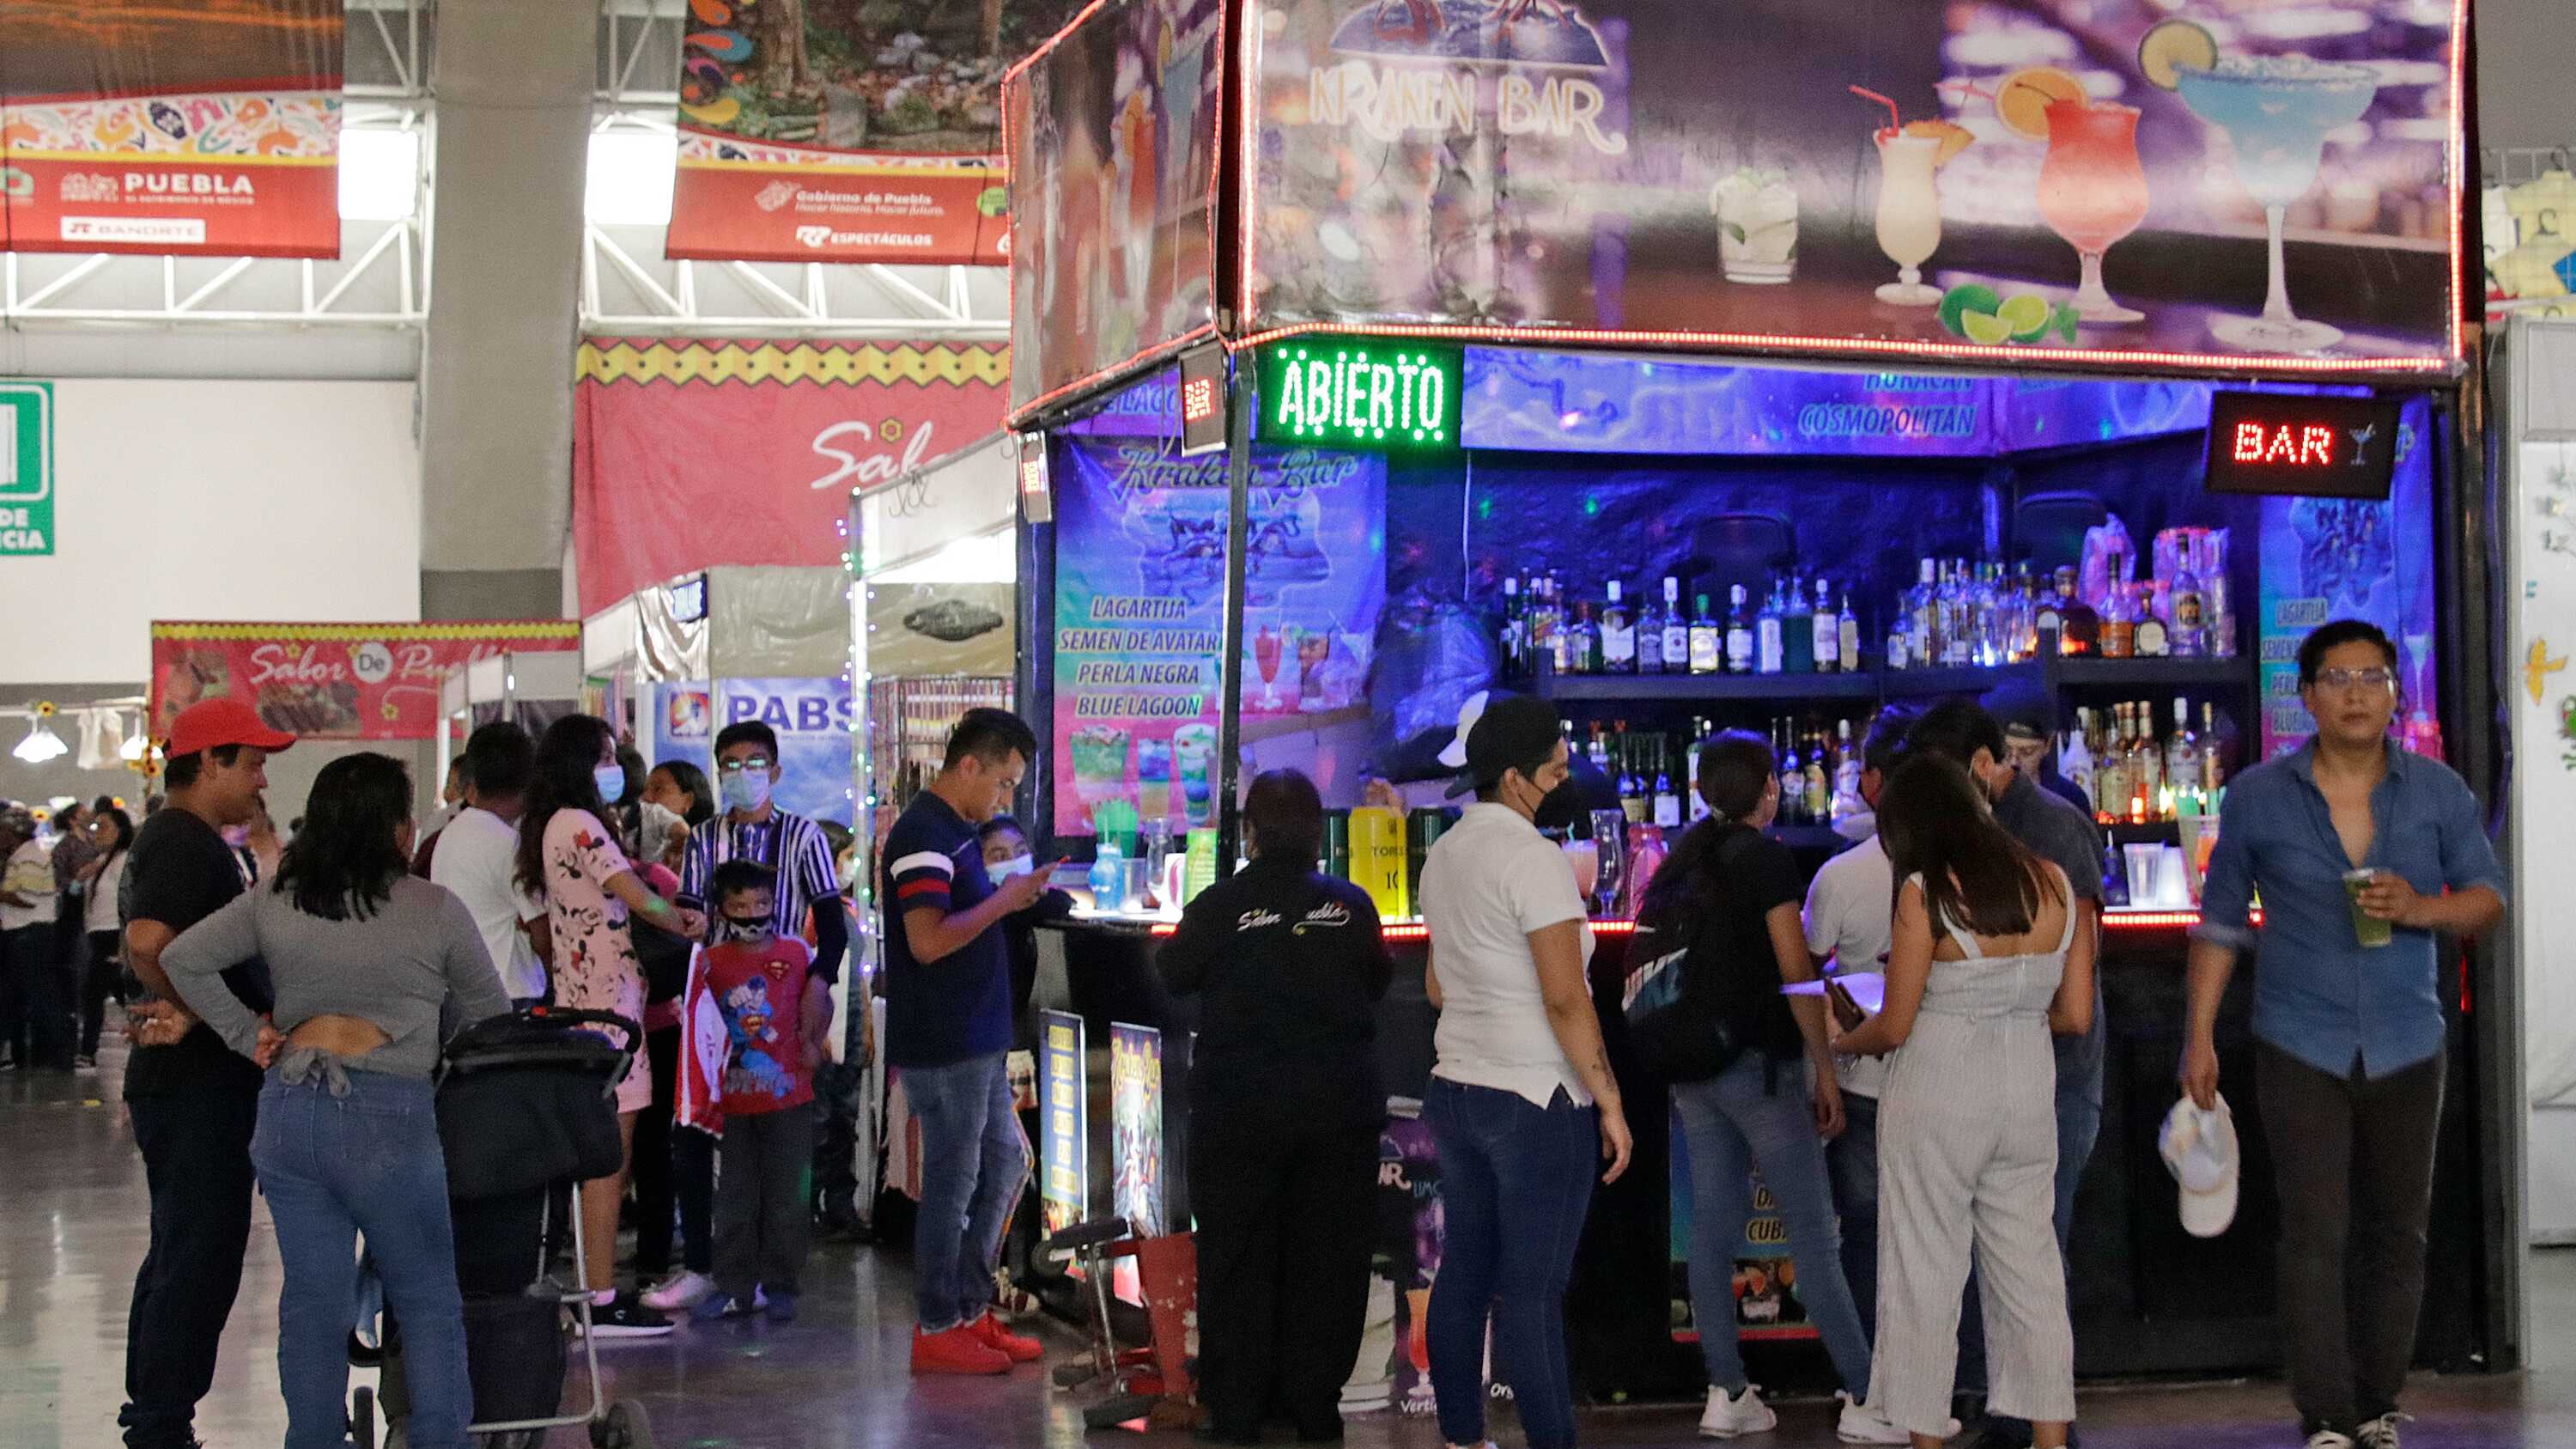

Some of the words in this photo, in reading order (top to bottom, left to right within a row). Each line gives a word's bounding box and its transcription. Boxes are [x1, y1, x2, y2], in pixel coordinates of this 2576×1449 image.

[1309, 58, 1477, 143] KRAKEN
[1498, 74, 1627, 155] BAR
[125, 173, 255, 194] PUEBLA
[1277, 357, 1445, 429] ABIERTO
[1800, 405, 1975, 435] COSMOPOLITAN
[2234, 423, 2330, 464] BAR
[0, 529, 46, 550] CIA
[1091, 598, 1187, 619] LAGARTIJA
[1059, 630, 1122, 651] SEMEN
[1126, 630, 1151, 651] DE
[1152, 630, 1218, 651] AVATAR
[249, 644, 348, 685] Sabor
[358, 654, 385, 673] De
[1078, 663, 1135, 684] PERLA
[1139, 664, 1200, 684] NEGRA
[1078, 697, 1124, 715] BLUE
[1127, 697, 1200, 715] LAGOON
[1748, 1220, 1787, 1241] CUB
